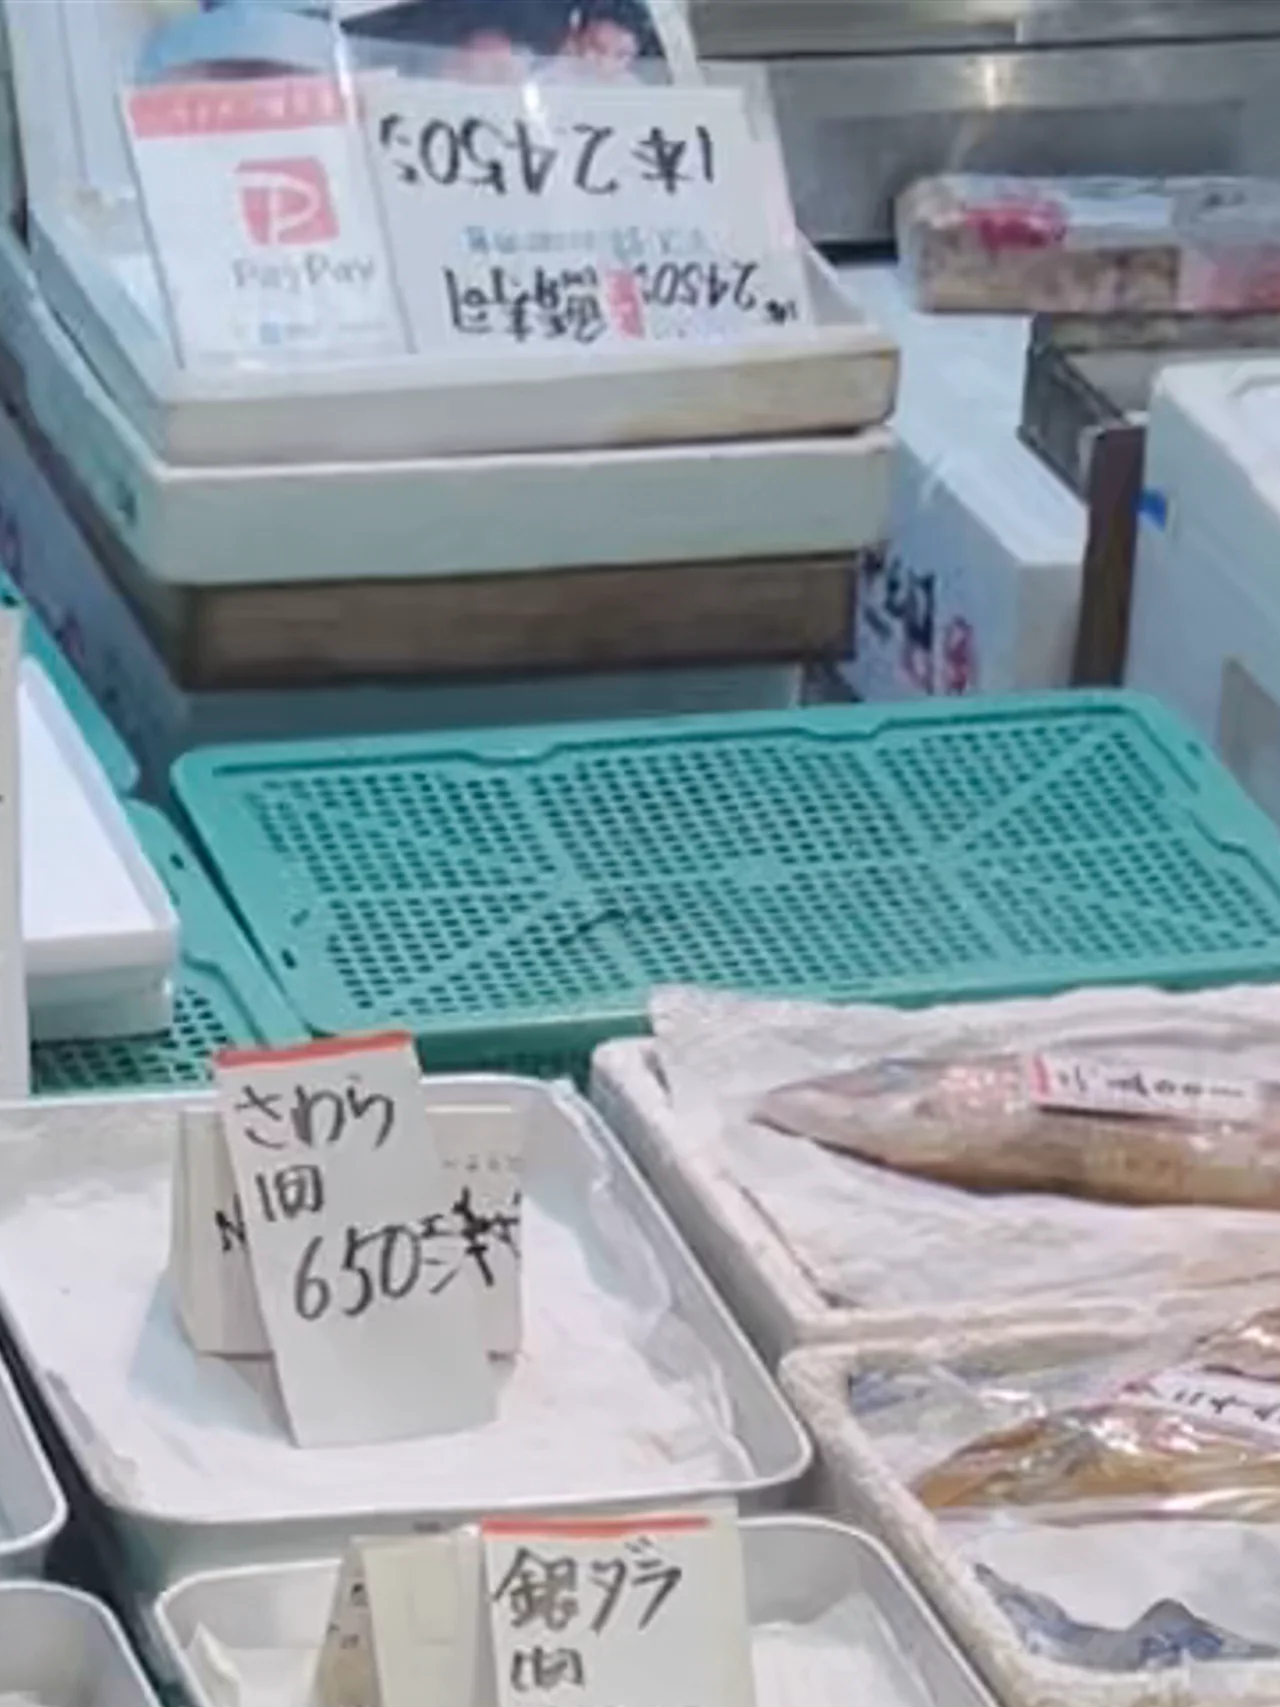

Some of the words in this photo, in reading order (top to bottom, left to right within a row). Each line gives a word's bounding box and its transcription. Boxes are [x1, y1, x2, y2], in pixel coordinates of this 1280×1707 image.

[231, 252, 374, 294] PayPay
[234, 1081, 395, 1151] さわら
